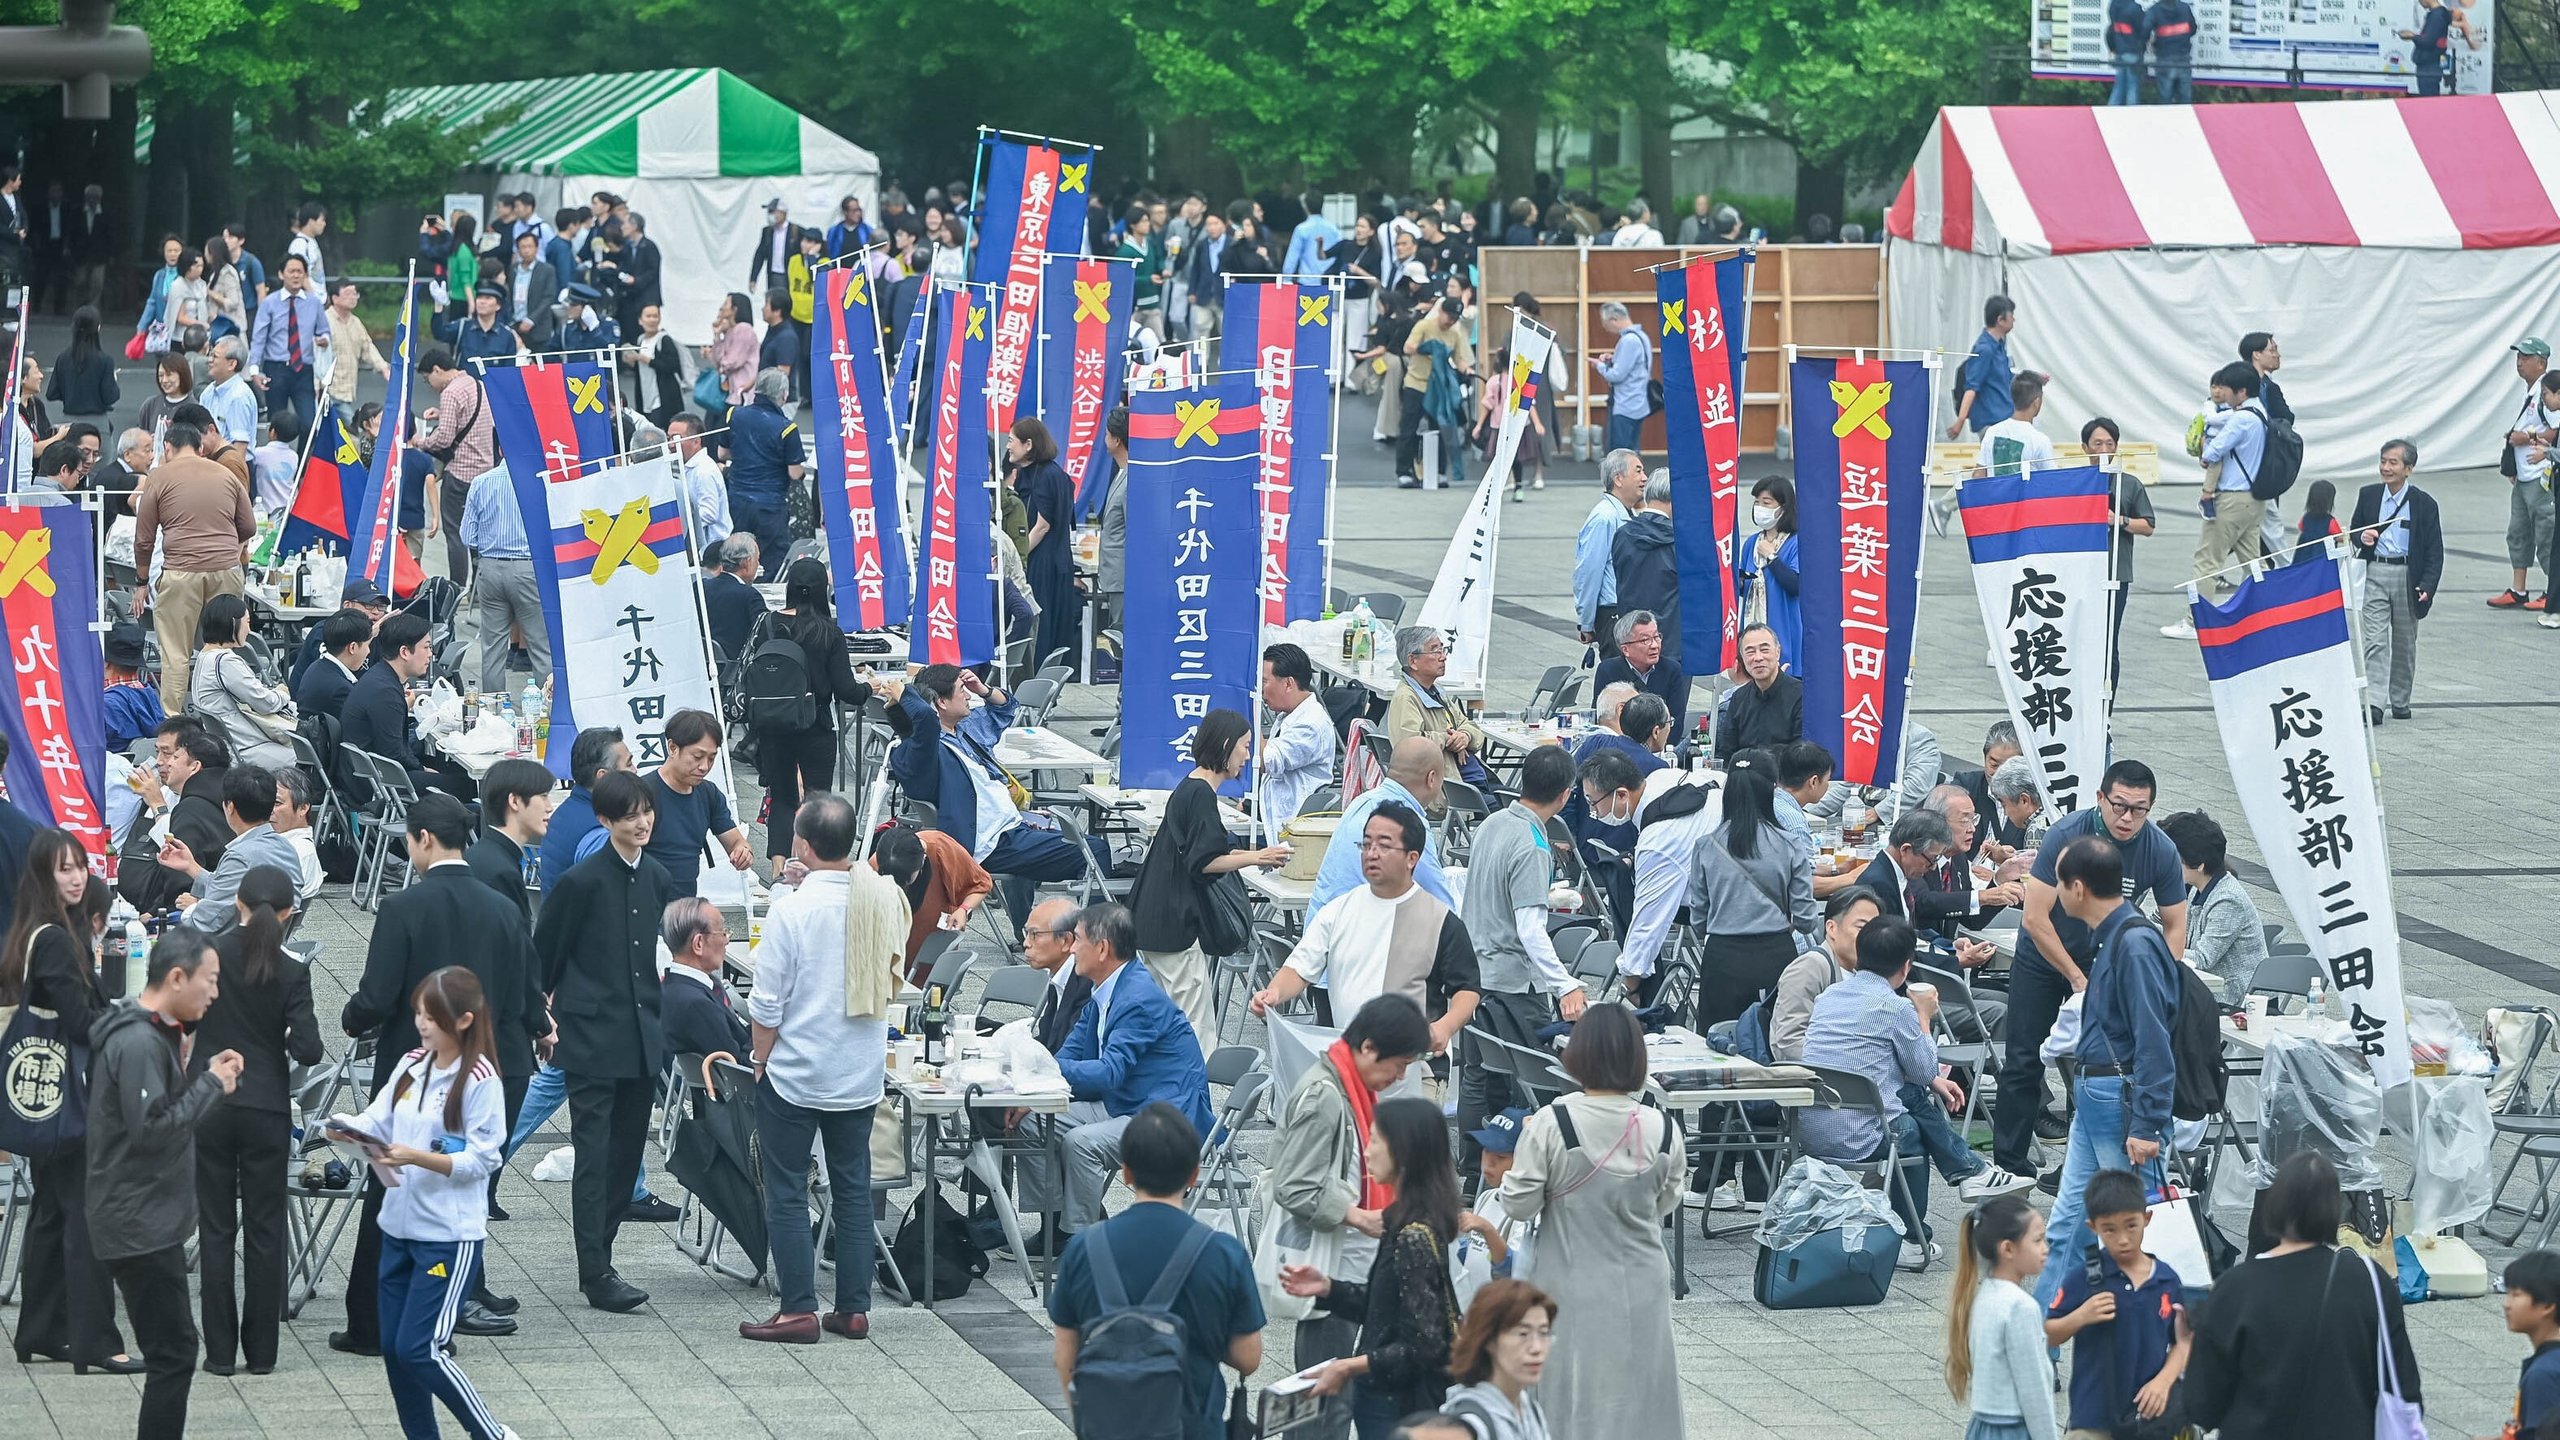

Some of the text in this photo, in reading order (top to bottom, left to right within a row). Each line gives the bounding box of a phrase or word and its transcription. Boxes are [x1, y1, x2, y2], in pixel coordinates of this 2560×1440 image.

[2269, 686, 2388, 1058] 応援部三田会
